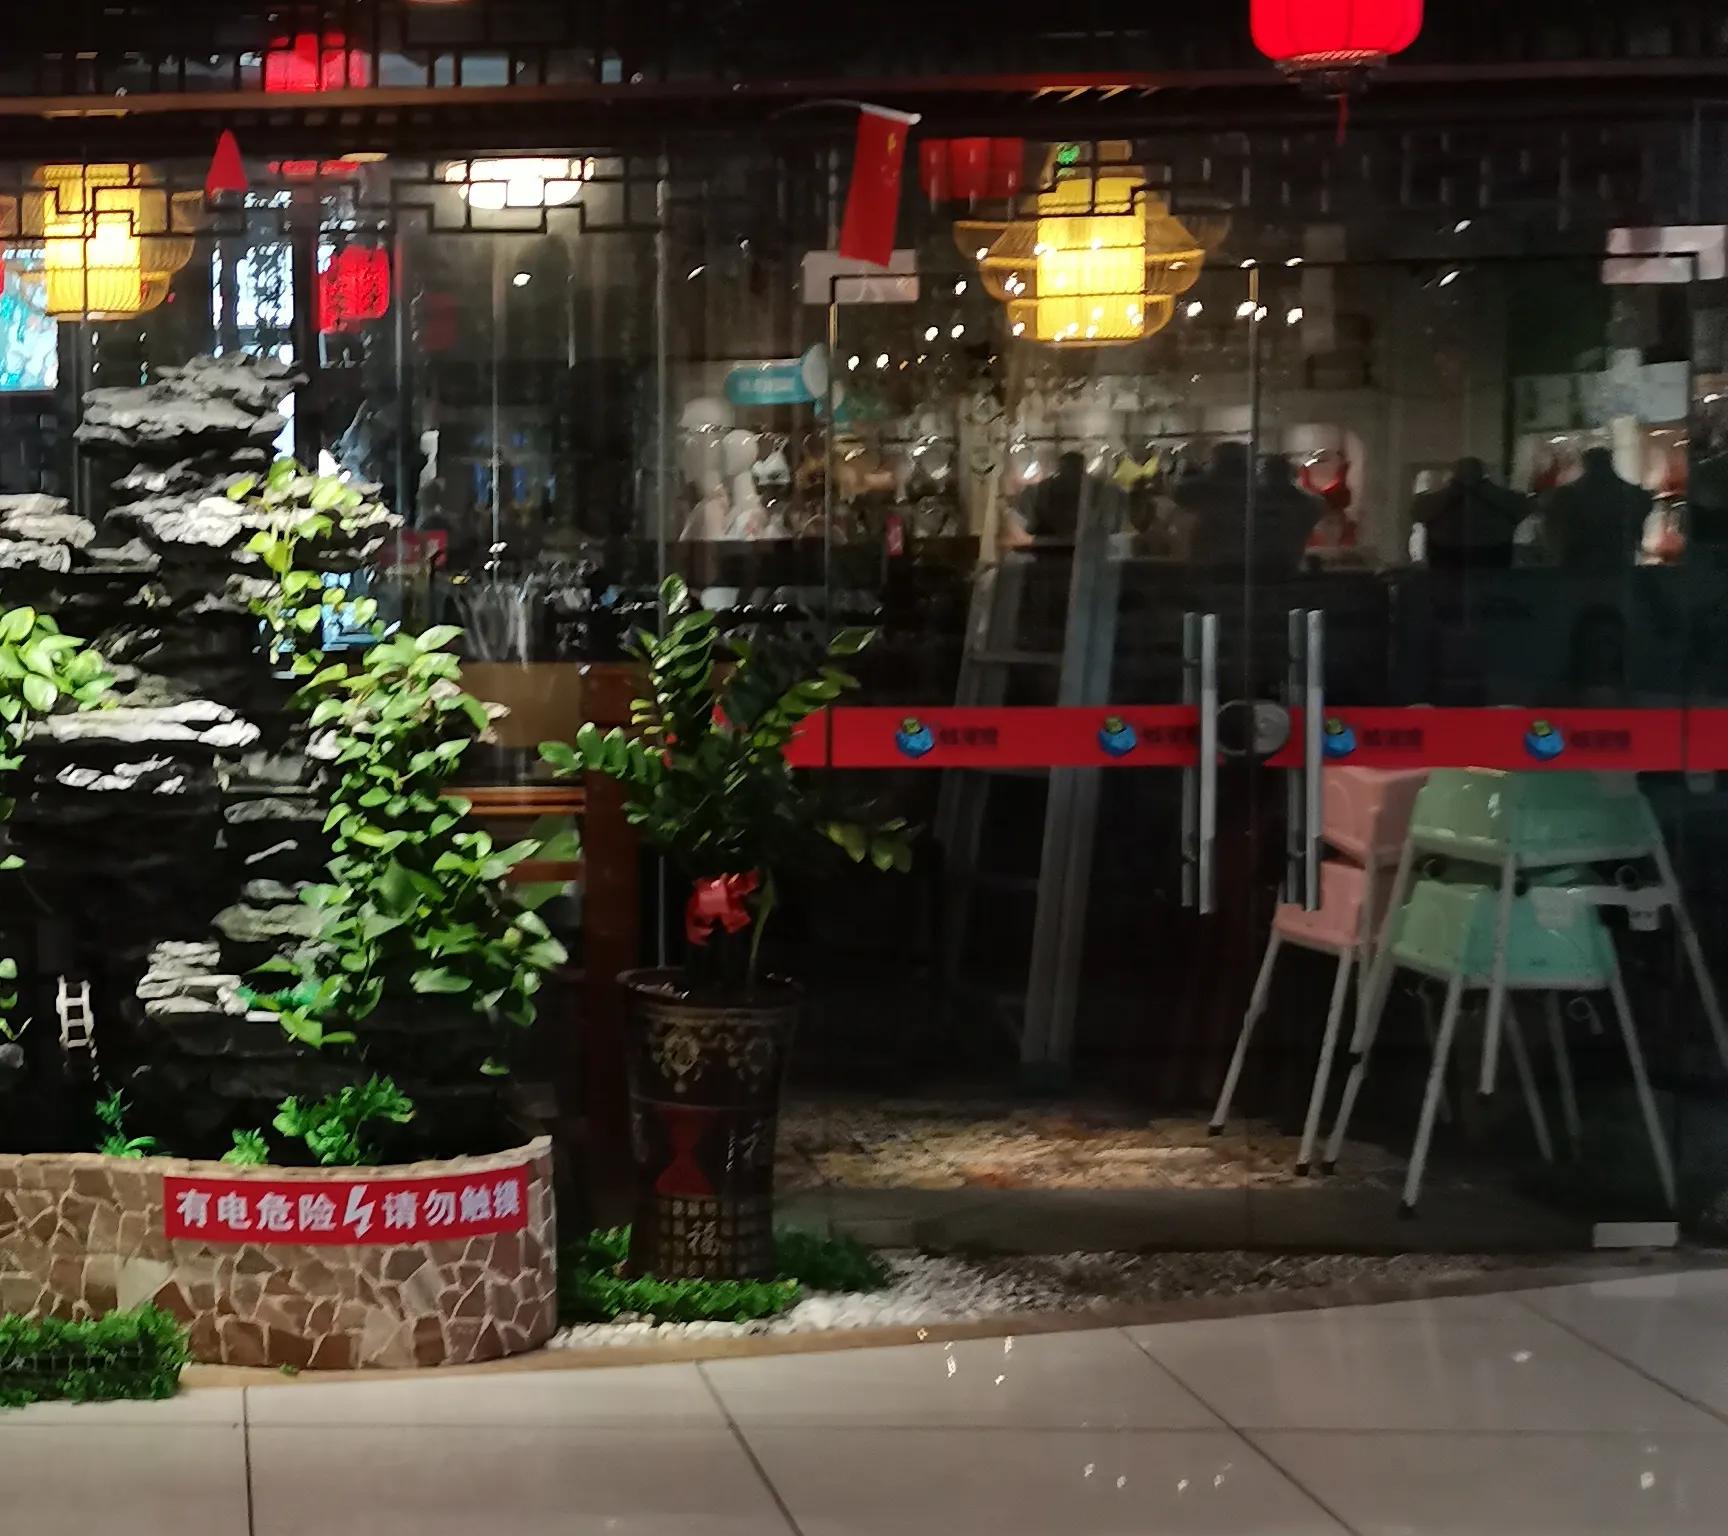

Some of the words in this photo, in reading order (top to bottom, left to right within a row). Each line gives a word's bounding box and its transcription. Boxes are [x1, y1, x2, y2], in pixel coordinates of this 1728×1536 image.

[175, 1188, 337, 1232] 有电危险
[381, 1177, 520, 1230] 请勿触摸
